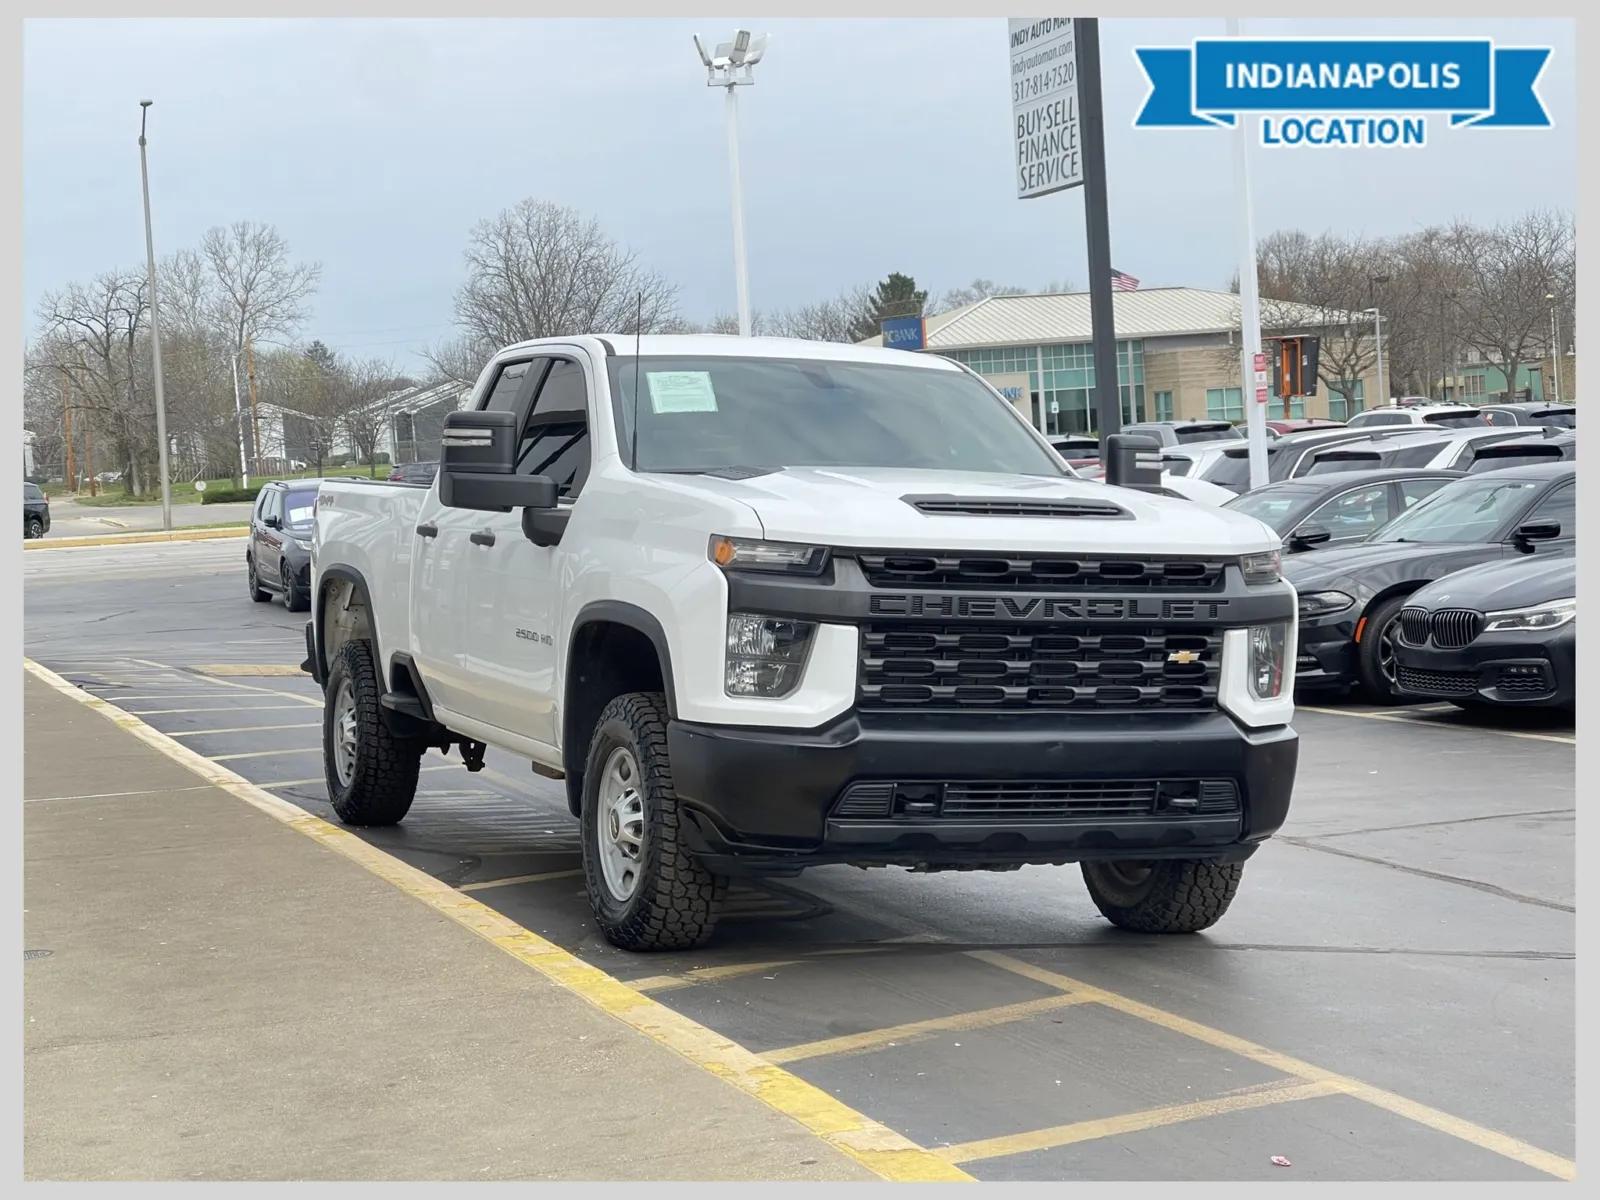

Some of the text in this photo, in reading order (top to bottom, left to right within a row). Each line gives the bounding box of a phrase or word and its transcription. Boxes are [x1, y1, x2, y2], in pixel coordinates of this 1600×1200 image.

[1011, 27, 1029, 48] INDY
[1031, 18, 1051, 40] AUTO
[1012, 41, 1073, 76] indyautoman.com
[1019, 123, 1077, 165] FINANCE
[1020, 151, 1079, 191] SERVICE
[895, 328, 919, 342] BANK
[868, 595, 1230, 620] CHEVROLET
[515, 627, 554, 647] 2500 HD
